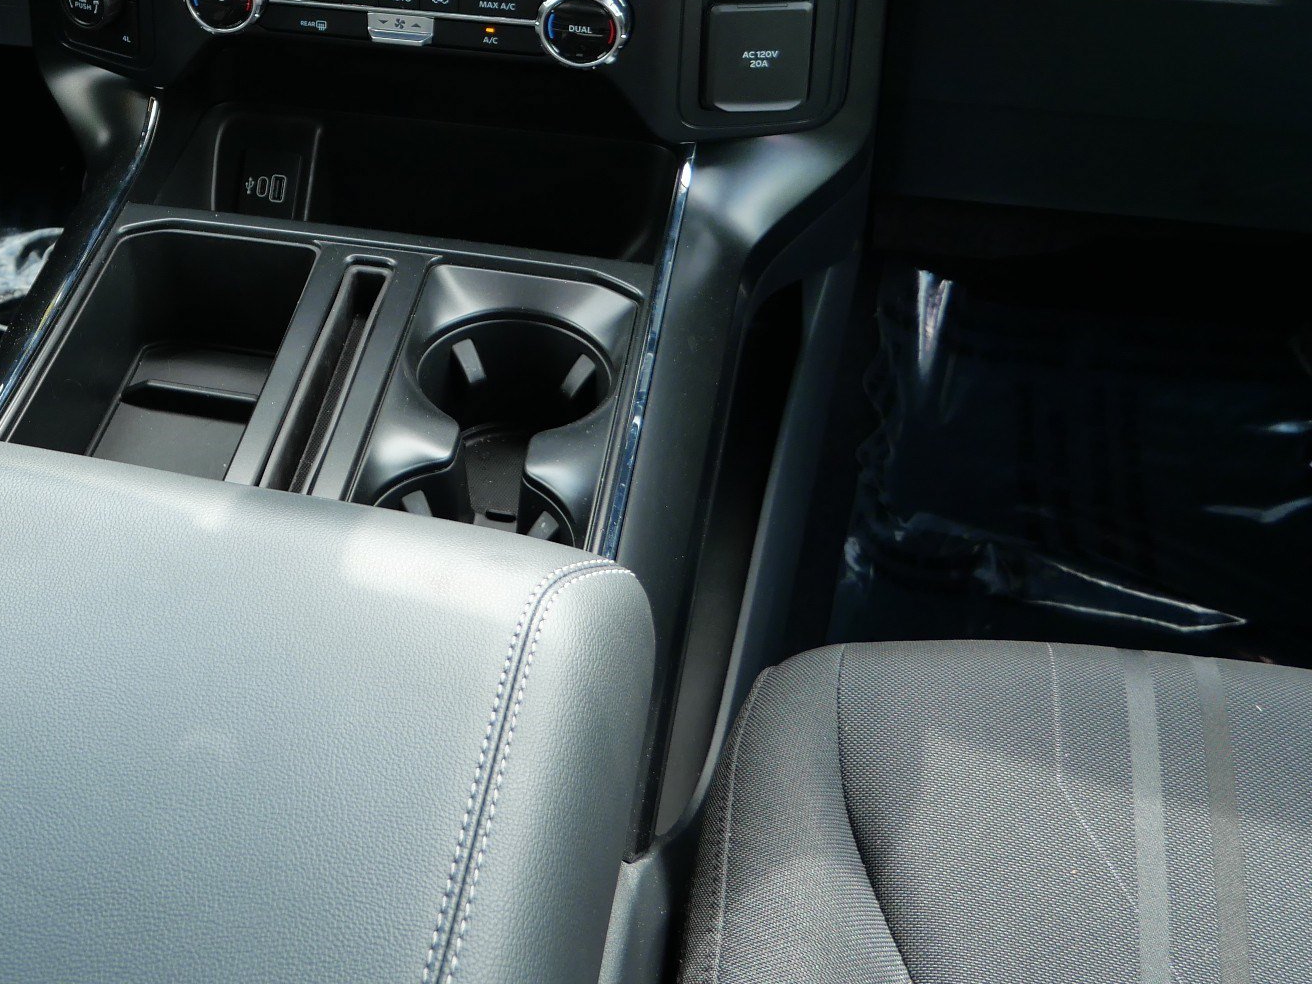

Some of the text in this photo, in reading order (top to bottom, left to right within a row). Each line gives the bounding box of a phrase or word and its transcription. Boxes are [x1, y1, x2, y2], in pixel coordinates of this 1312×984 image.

[75, 1, 92, 10] PUSH
[479, 1, 516, 11] MAX A/C
[568, 24, 593, 34] DUAL
[742, 50, 779, 59] AC 120V
[749, 60, 769, 68] 20A
